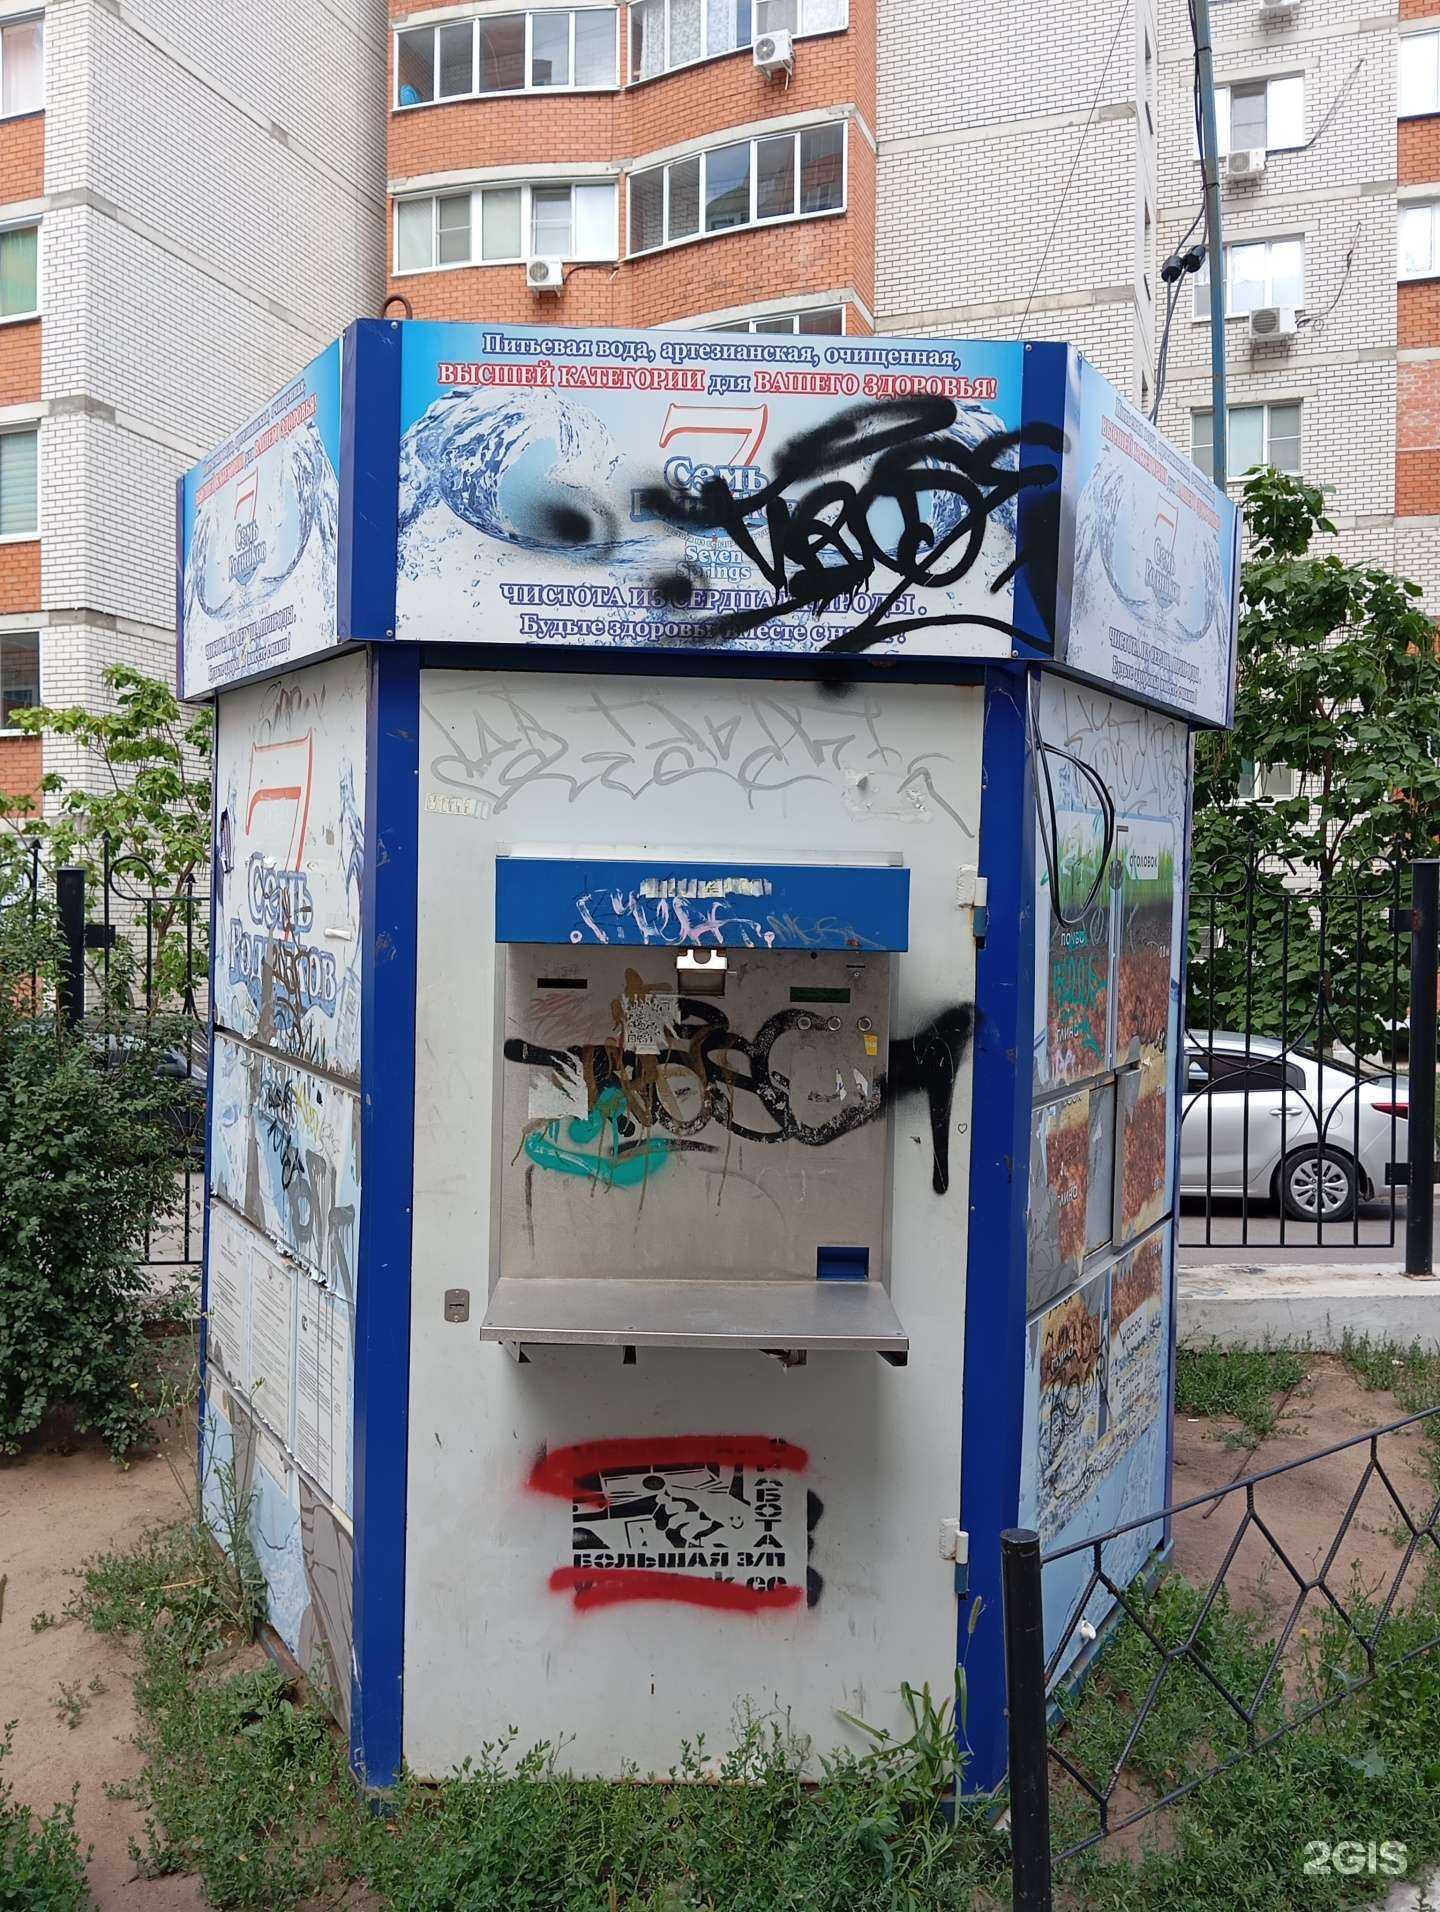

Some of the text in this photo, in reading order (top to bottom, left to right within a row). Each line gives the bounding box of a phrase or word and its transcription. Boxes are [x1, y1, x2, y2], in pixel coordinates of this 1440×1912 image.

[482, 333, 960, 371] Питьевая вода, артезианская, очищенная,
[437, 361, 998, 400] ВЫСШЕЙ КАТЕГОРИИ для ВАШЕГО ЗДОРОВЬЯ!
[659, 402, 769, 467] 7
[685, 545, 744, 564] Seven
[500, 583, 627, 608] ЧИСТОТА
[520, 613, 606, 639] Будьте
[809, 625, 826, 642] с
[753, 1464, 784, 1549] АБОТА
[573, 1551, 729, 1570] БОЛЬШАЯ
